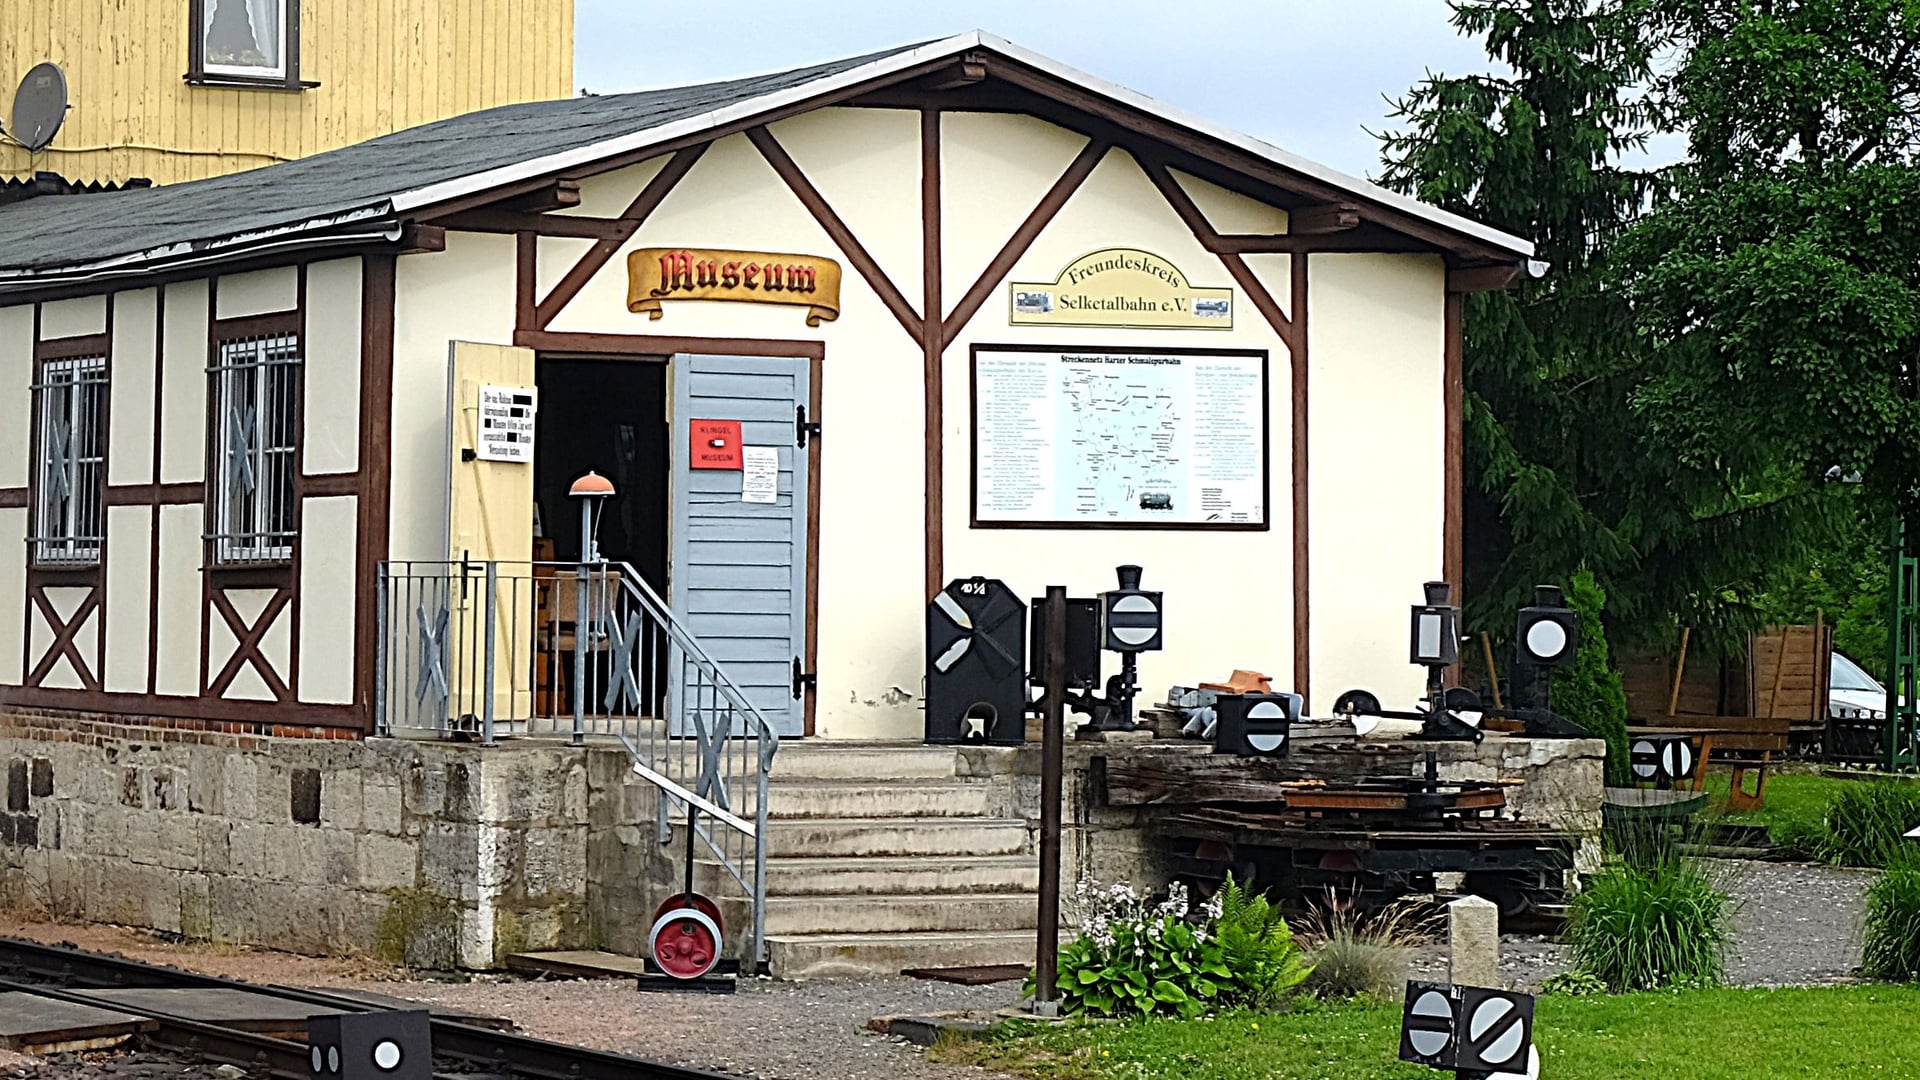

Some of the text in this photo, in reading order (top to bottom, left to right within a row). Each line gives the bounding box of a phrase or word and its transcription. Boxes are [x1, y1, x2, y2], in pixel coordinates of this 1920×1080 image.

[650, 249, 817, 297] Museum
[1068, 254, 1181, 288] Freundeskreis
[1059, 294, 1188, 313] Selketalbahn e.V.
[700, 426, 732, 435] KLINGEL
[701, 454, 734, 462] MUSEUM
